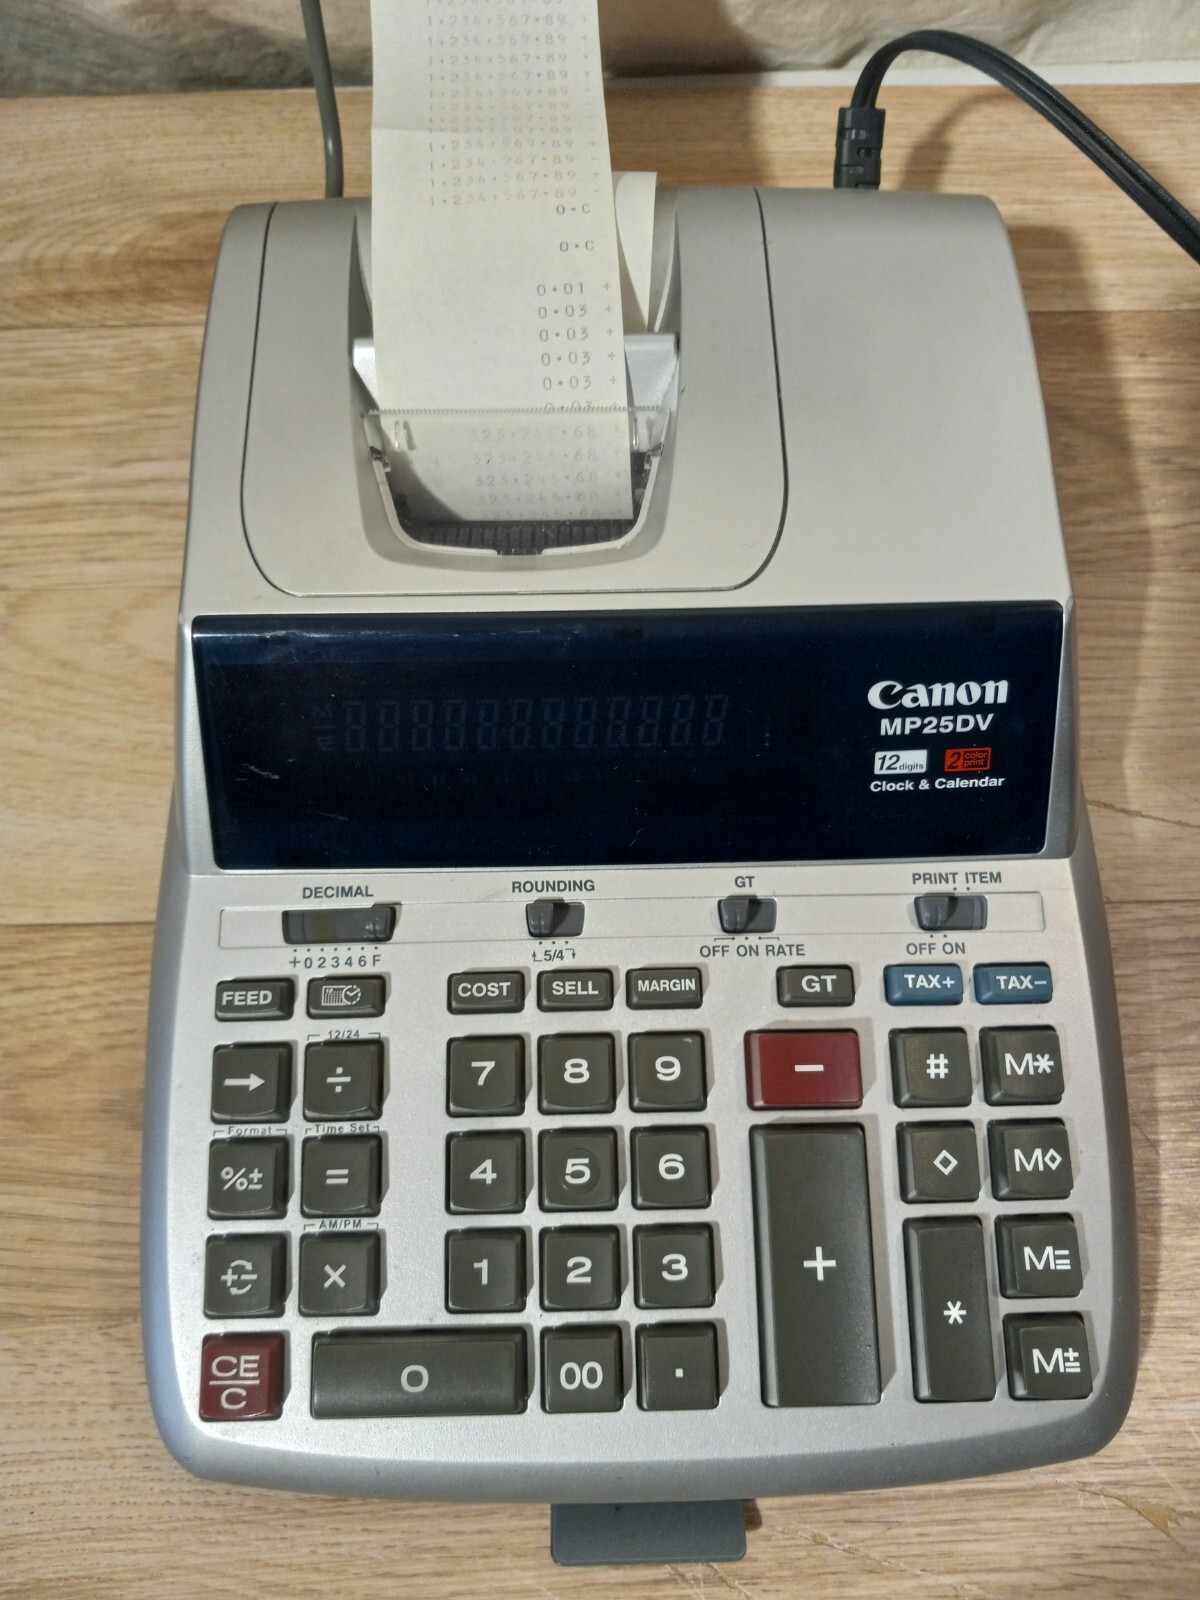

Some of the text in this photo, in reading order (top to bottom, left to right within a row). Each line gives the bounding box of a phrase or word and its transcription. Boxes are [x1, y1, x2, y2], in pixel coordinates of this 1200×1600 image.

[867, 680, 1009, 710] Canon
[880, 713, 995, 736] MP25DV
[964, 750, 988, 759] color
[963, 759, 985, 768] print
[870, 776, 1005, 792] Clock & Calendar
[511, 879, 596, 893] ROUNDING
[734, 875, 755, 888] GT
[912, 871, 1002, 885] PRINT ITEM
[302, 886, 374, 899] DECIMAL
[699, 943, 806, 958] OFF ON RATE
[906, 942, 966, 955] OFF ON
[457, 981, 511, 997] COST
[552, 980, 599, 996] SELL
[637, 977, 696, 992] MARGIN
[801, 974, 837, 993] GT
[221, 990, 272, 1006] FEED
[328, 1030, 360, 1039] 12/24
[471, 1060, 496, 1086] 7
[563, 1058, 590, 1084] 8
[654, 1056, 681, 1081] 9
[227, 1126, 272, 1135] Format
[315, 1123, 370, 1133] Time Set
[469, 1159, 497, 1185] 4
[564, 1158, 591, 1184] 5
[658, 1153, 685, 1180] 6
[319, 1220, 362, 1229] AM/PM
[473, 1258, 489, 1285] 1
[566, 1256, 593, 1283] 2
[661, 1253, 689, 1281] 3
[211, 1355, 260, 1377] CE
[559, 1361, 603, 1390] 00
[221, 1387, 247, 1410] C
